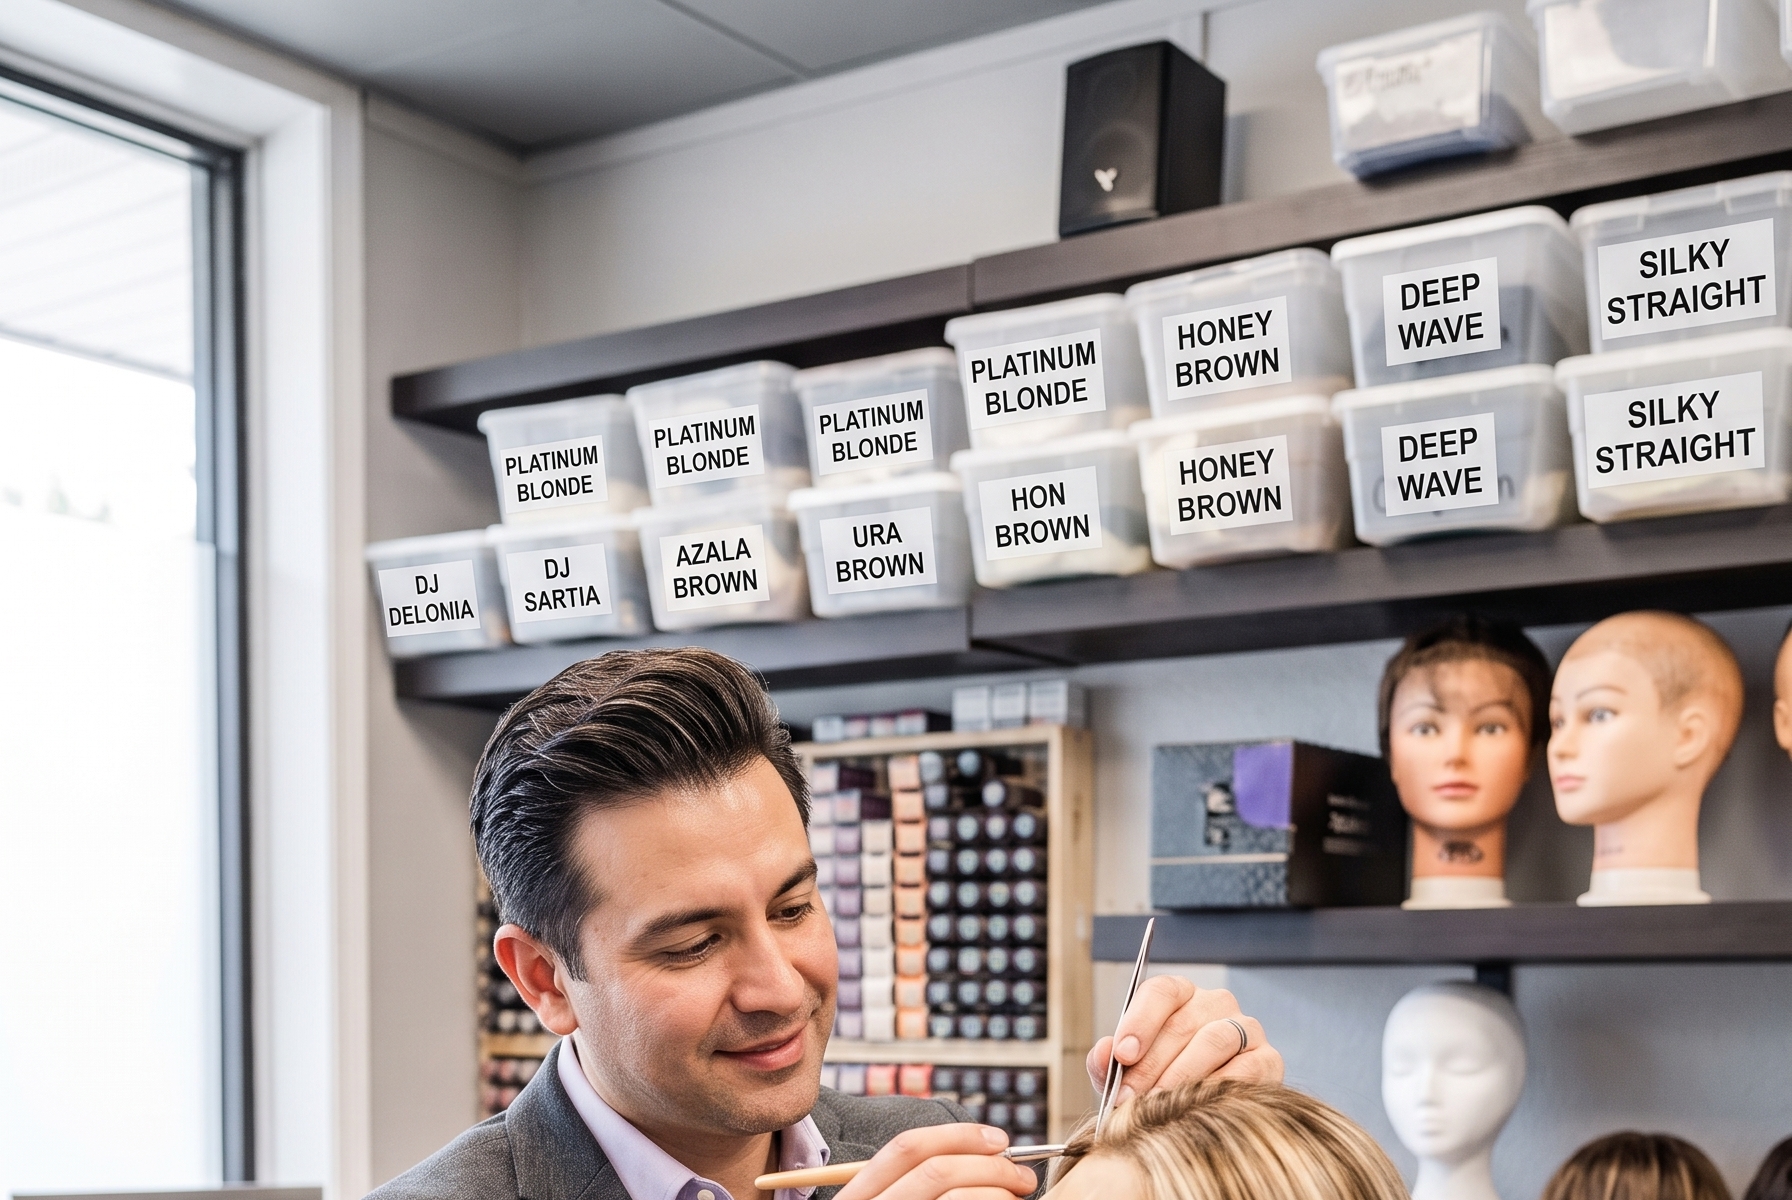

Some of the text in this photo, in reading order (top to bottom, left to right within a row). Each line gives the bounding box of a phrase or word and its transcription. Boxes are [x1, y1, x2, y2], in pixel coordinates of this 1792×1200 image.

[1639, 238, 1730, 279] SILKY
[1400, 272, 1480, 311] DEEP
[1607, 274, 1767, 325] STRAIGHT
[1177, 309, 1273, 351] HONEY
[1397, 311, 1484, 351] WAVE
[971, 340, 1096, 384] PLATINUM
[1175, 347, 1280, 388] BROWN
[985, 377, 1088, 416] BLONDE
[1628, 390, 1720, 429] SILKY
[654, 415, 756, 449] PLATINUM
[819, 399, 924, 435] PLATINUM
[505, 445, 598, 477] PLATINUM
[666, 445, 750, 476] BLONDE
[831, 430, 918, 463] BLONDE
[1398, 427, 1478, 463] DEEP
[1595, 427, 1756, 474] STRAIGHT
[1179, 448, 1275, 486] HONEY
[1397, 466, 1483, 502] WAVE
[516, 474, 594, 503] BLONDE
[1011, 481, 1066, 512] HON
[1177, 485, 1282, 522] BROWN
[852, 521, 903, 548] URA
[995, 513, 1090, 548] BROWN
[544, 556, 570, 580] DJ
[676, 537, 752, 568] AZALA
[835, 551, 924, 583] BROWN
[415, 573, 439, 595] DJ
[524, 585, 601, 612] SARTIA
[673, 568, 758, 599] BROWN
[388, 599, 475, 627] DELONIA
